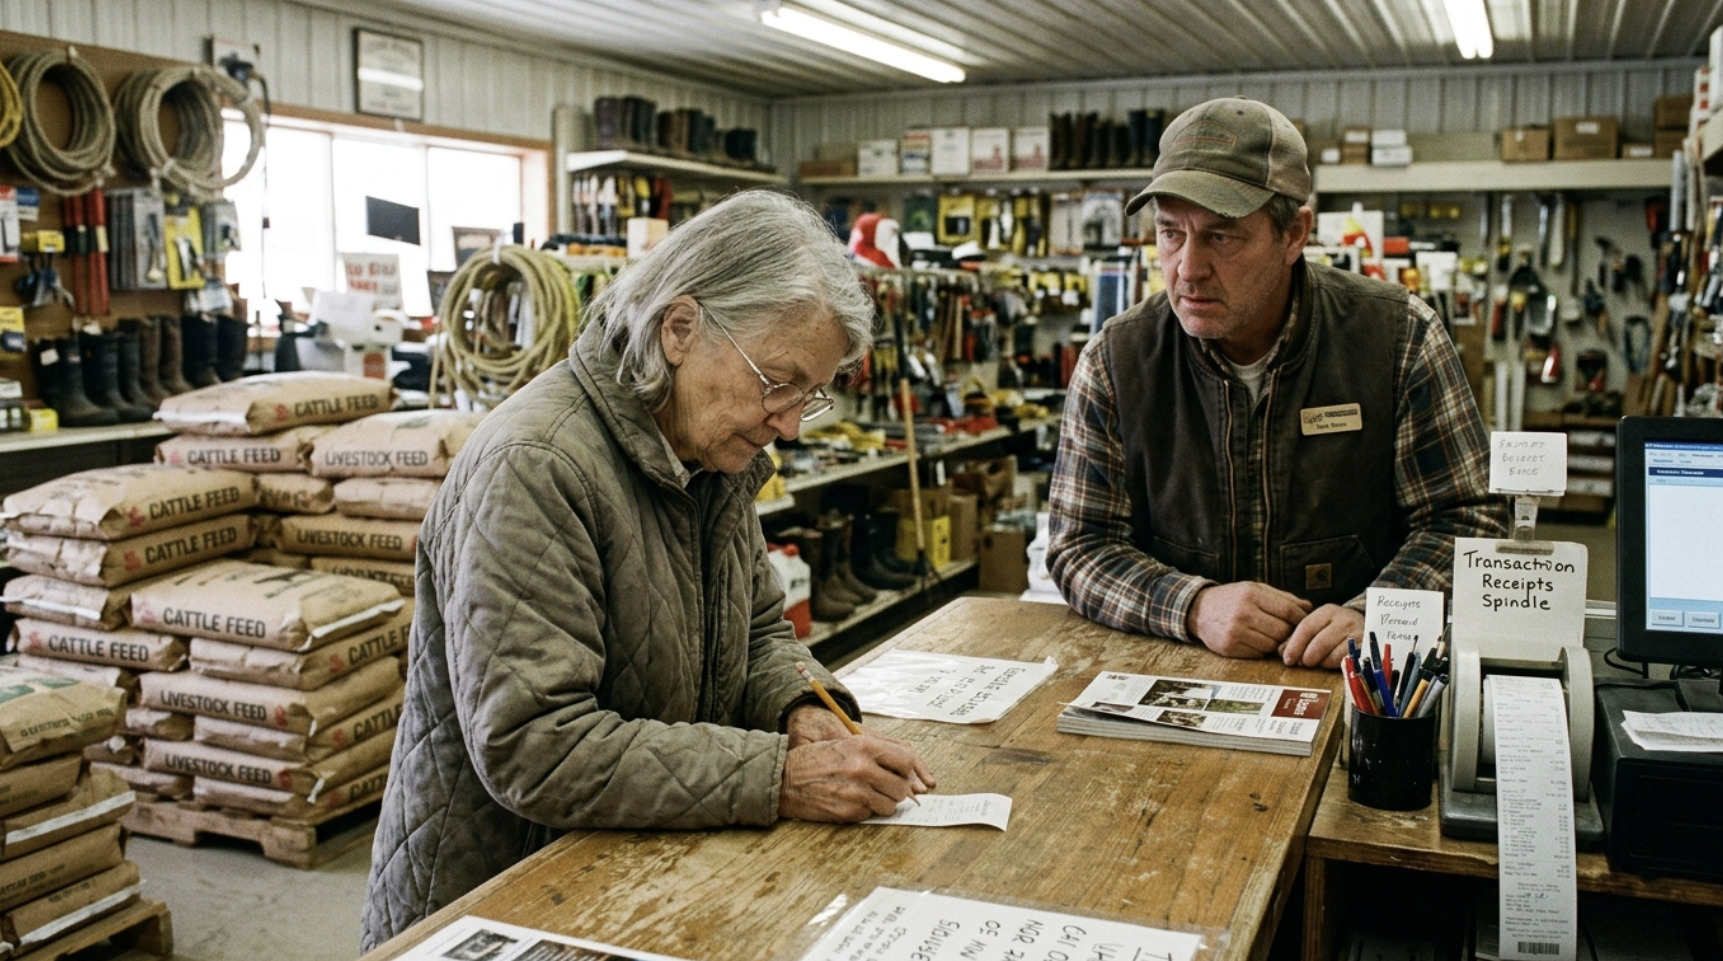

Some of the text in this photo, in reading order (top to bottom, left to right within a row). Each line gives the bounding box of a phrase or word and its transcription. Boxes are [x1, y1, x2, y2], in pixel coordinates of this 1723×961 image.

[294, 394, 379, 418] CATTLE FEED
[187, 448, 281, 465] CATTLE FEED
[325, 451, 428, 466] LIVESTOCK FEED
[150, 496, 202, 520] CATTLE
[205, 486, 240, 505] FEED
[145, 526, 238, 564] CATTLE FEED
[370, 533, 403, 550] FEED
[1482, 573, 1554, 598] Receipts
[1482, 594, 1551, 612] Spindle
[163, 608, 266, 639] CATTLE FEED
[48, 635, 149, 662] CATTLE FEED
[348, 630, 398, 665] CATTLE
[160, 690, 267, 721] LIVESTOCK FEED
[165, 754, 271, 784] LIVESTOCK FEED
[350, 774, 388, 800] CATT
